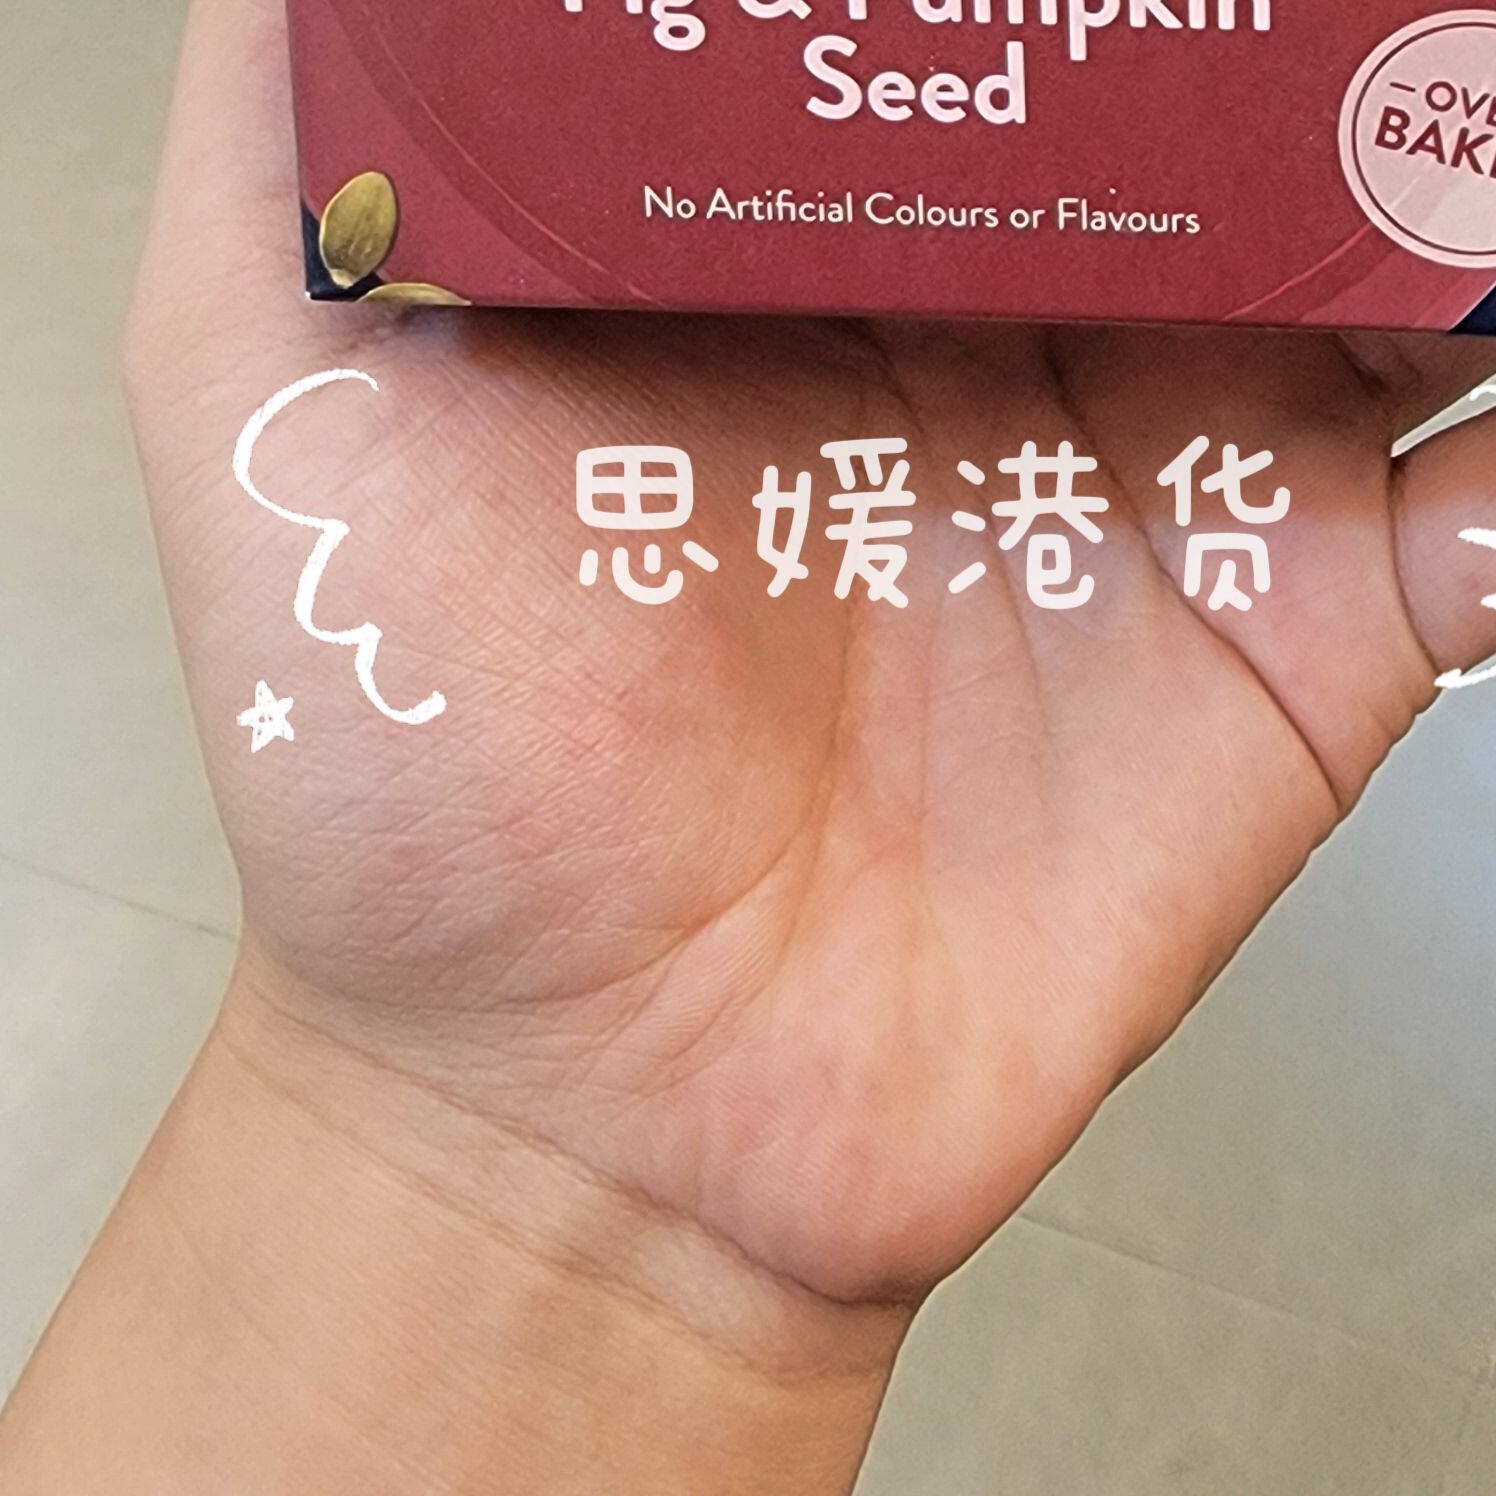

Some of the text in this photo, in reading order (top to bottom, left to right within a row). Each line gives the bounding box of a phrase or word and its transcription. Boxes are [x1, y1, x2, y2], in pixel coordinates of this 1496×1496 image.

[804, 35, 1027, 125] Seed
[644, 185, 1201, 234] No Artificial Colours or Flavours
